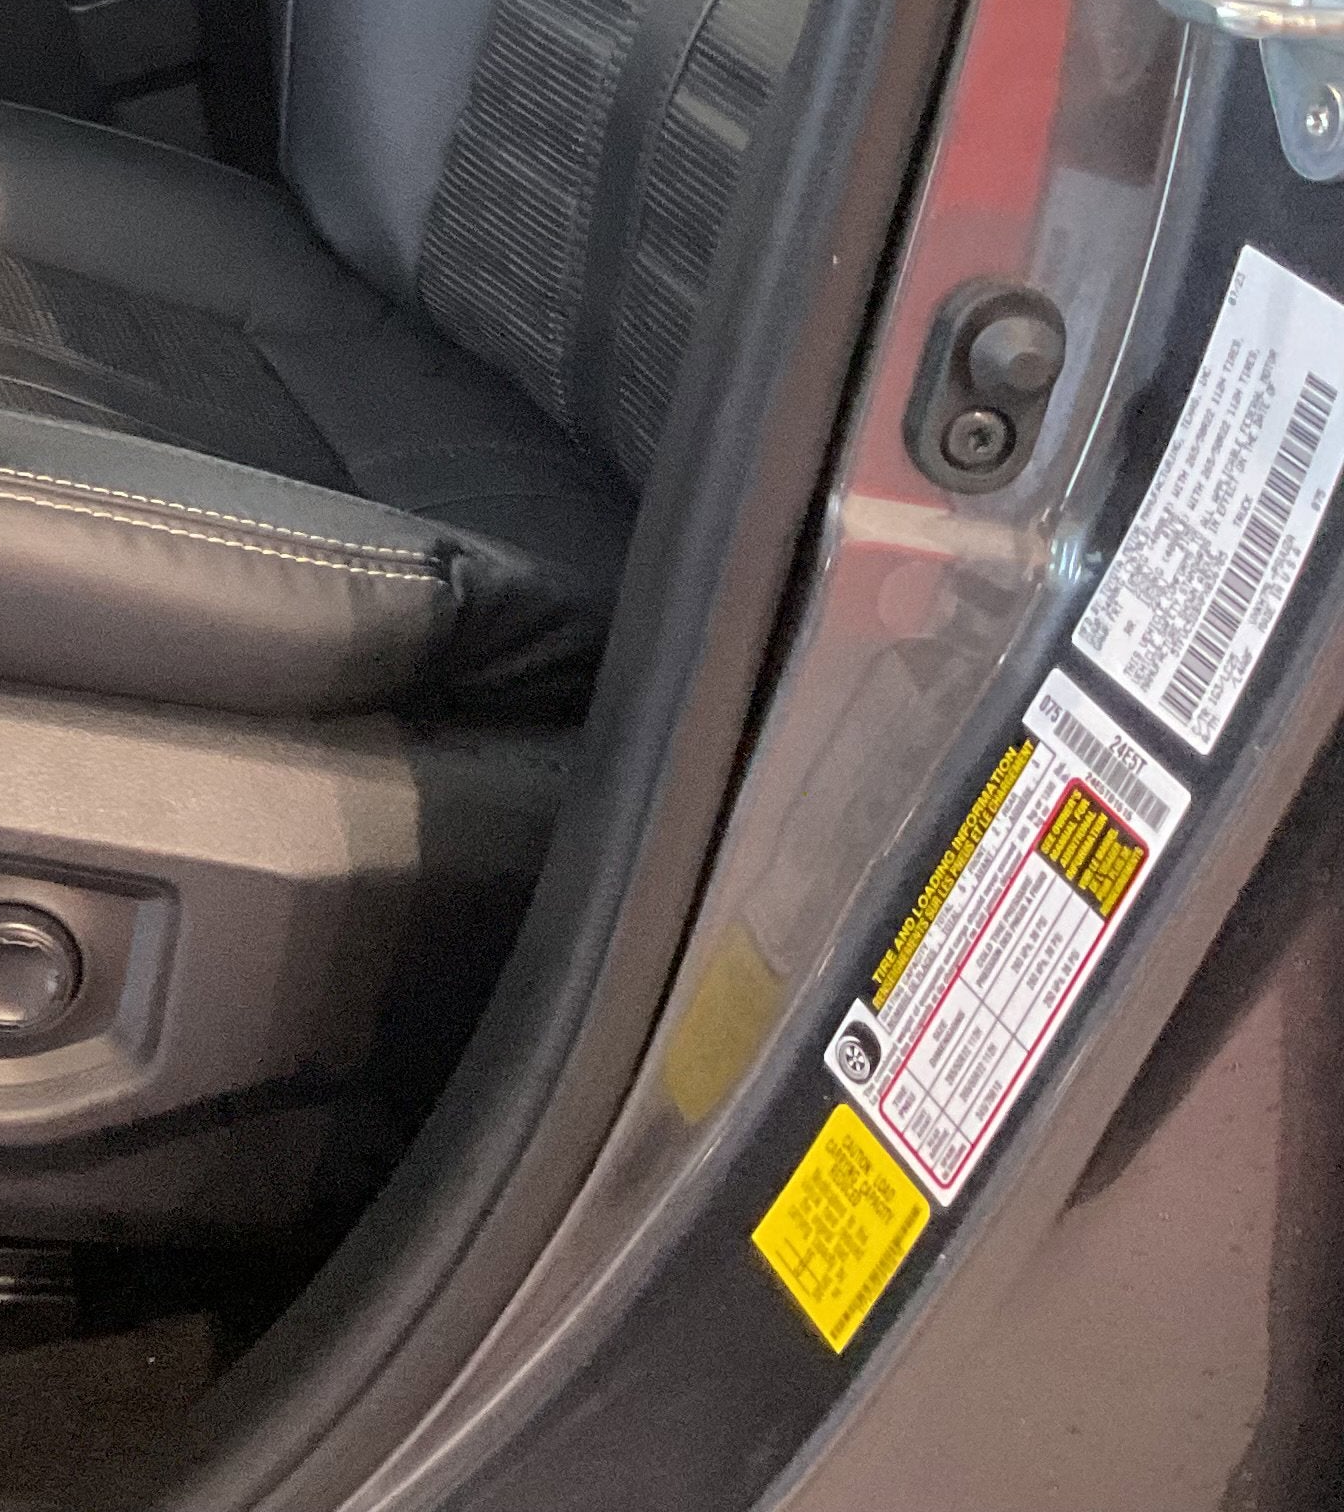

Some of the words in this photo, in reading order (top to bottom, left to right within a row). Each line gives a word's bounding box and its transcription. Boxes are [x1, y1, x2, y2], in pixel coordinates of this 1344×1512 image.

[1039, 693, 1063, 724] 075
[1109, 733, 1146, 777] 24E5T
[873, 948, 896, 983] TIRE
[892, 915, 916, 951] AND
[912, 849, 955, 917] LOADING
[952, 746, 1016, 851] INFORMATION
[924, 895, 942, 920] SUR
[938, 875, 954, 898] LES
[970, 825, 983, 842] ET
[979, 810, 992, 827] LE
[988, 738, 1034, 813] CHARGEMENT
